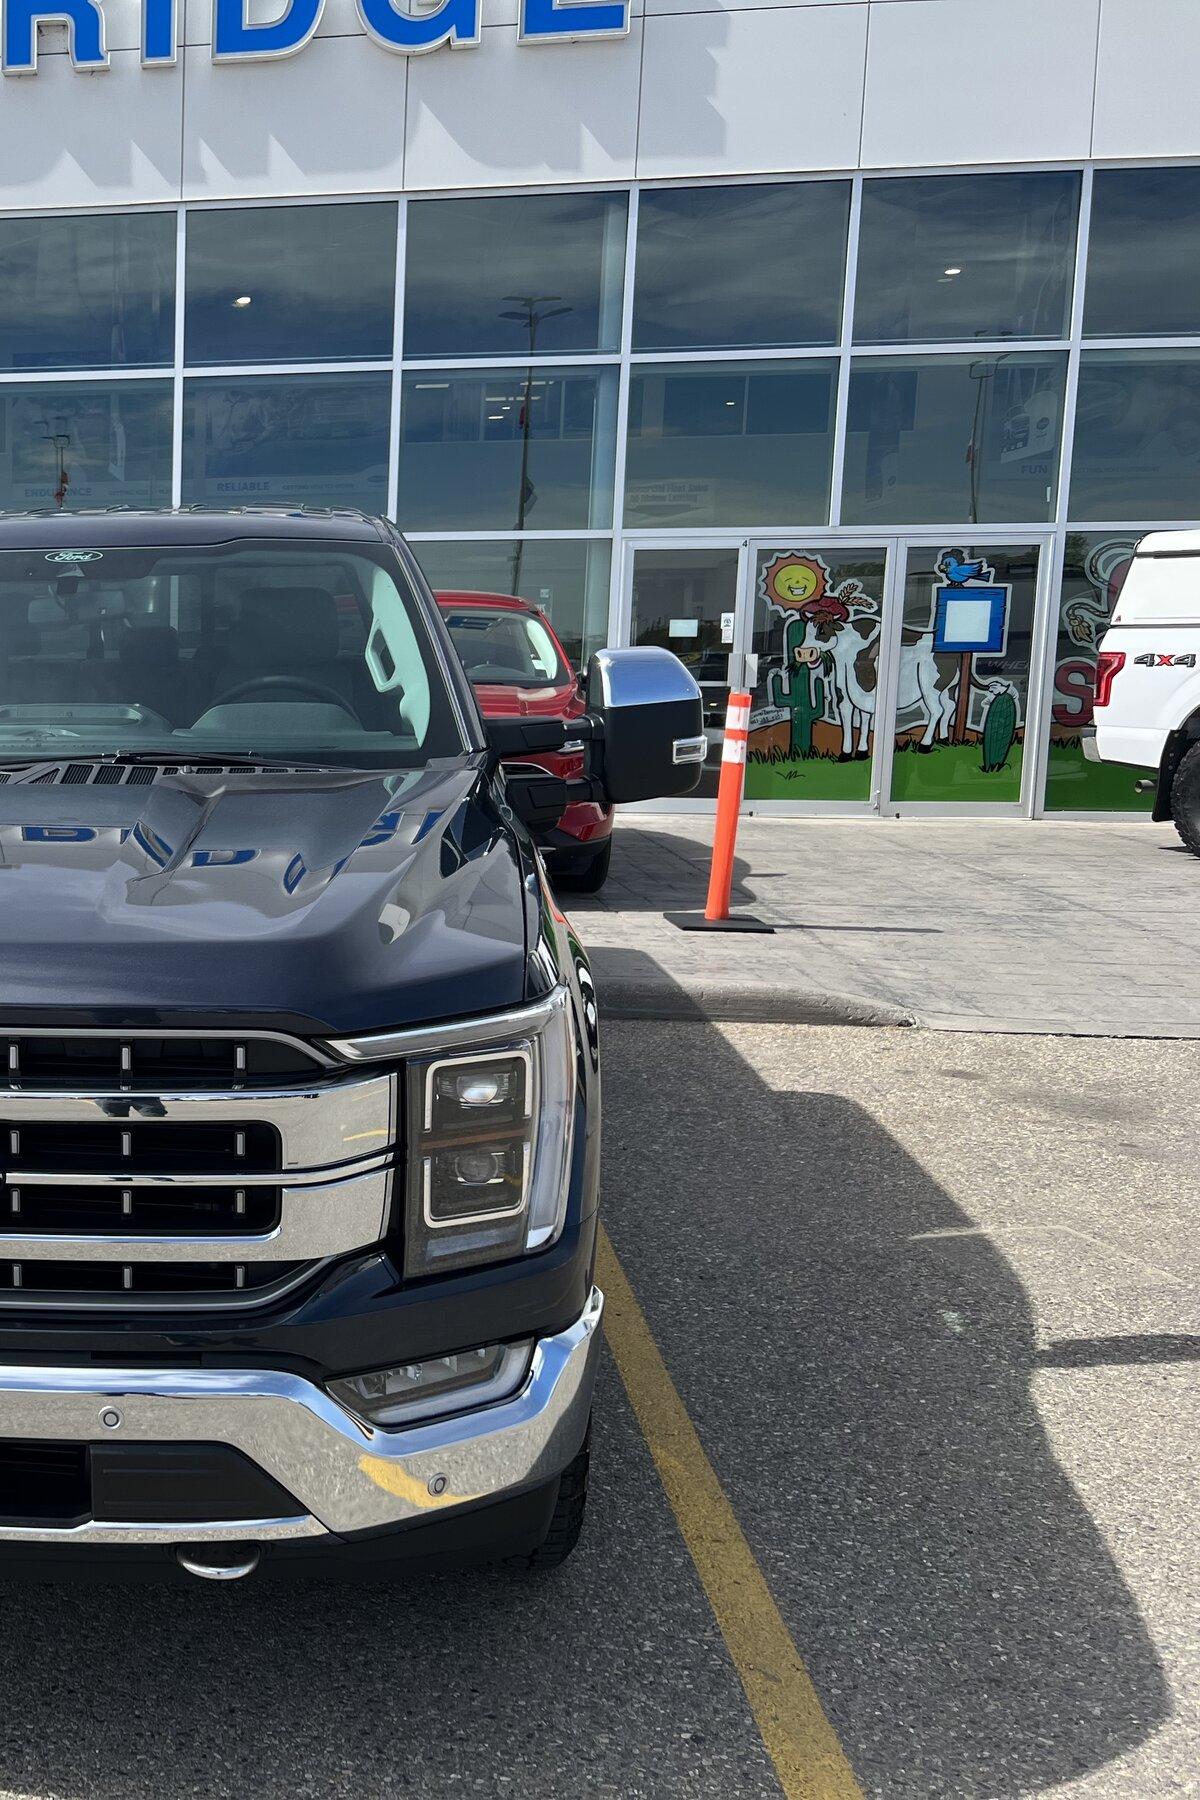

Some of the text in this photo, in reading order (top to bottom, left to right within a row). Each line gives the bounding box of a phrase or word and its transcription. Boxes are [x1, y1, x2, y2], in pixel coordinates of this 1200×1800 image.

[1021, 464, 1047, 474] FUN
[217, 481, 271, 492] RELIABLE
[25, 487, 92, 498] ENDUNCE
